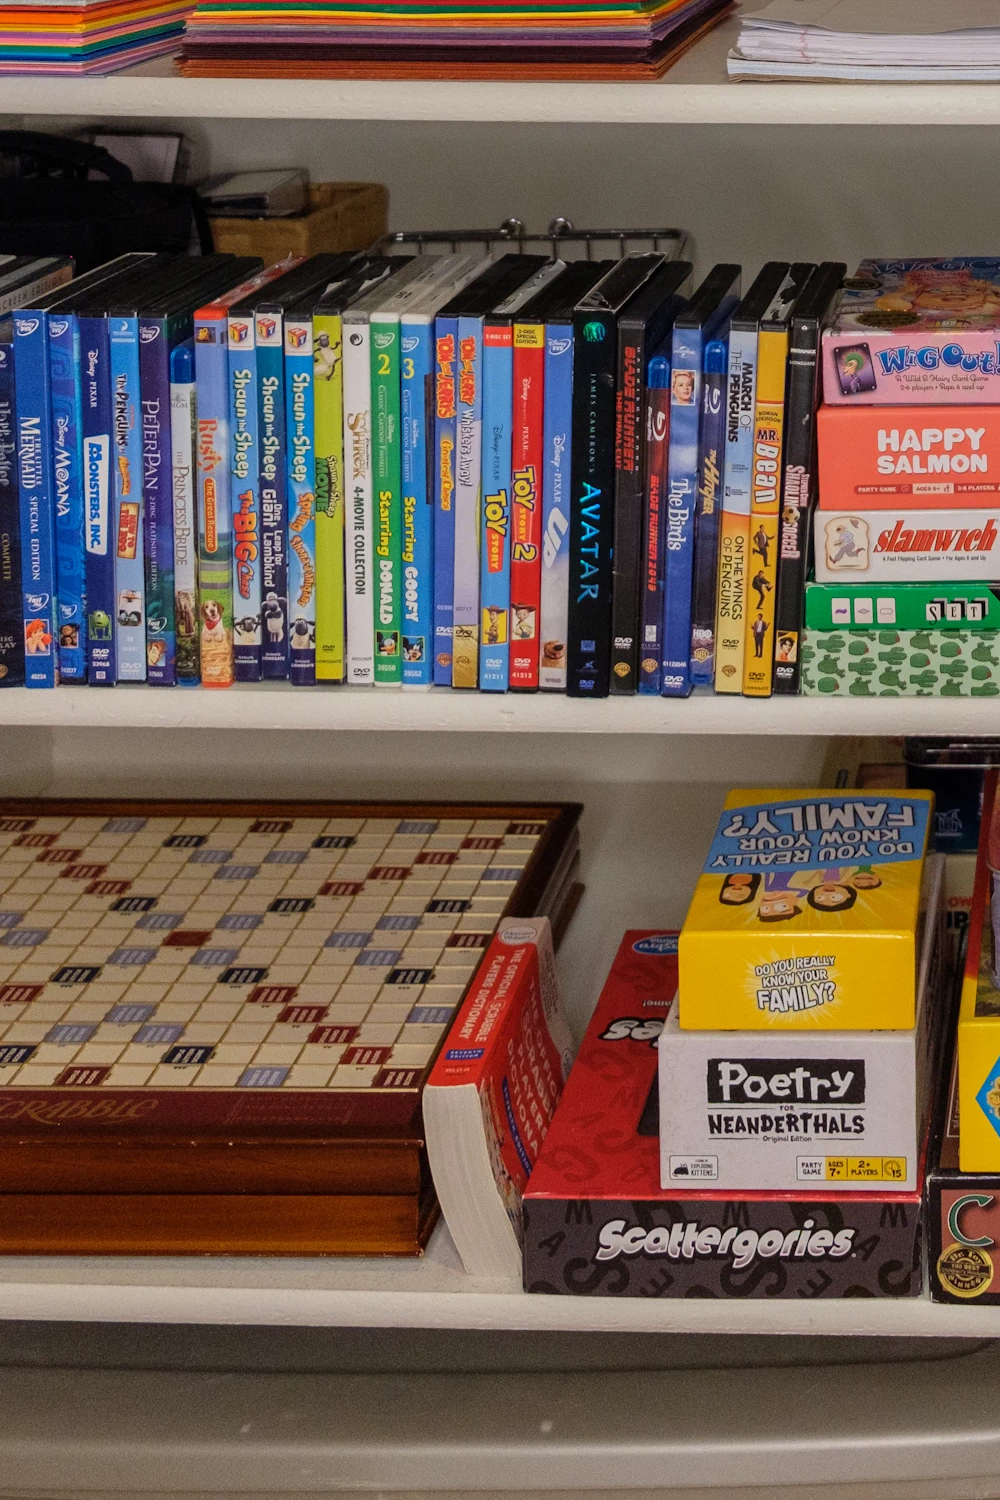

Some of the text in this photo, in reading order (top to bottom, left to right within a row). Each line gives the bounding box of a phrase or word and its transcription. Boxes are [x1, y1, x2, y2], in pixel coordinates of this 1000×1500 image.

[378, 354, 391, 375] 2
[403, 358, 415, 379] 3
[460, 336, 476, 361] TOM
[623, 346, 636, 471] BLADE RUNNER
[728, 374, 740, 443] PENGUINS
[740, 362, 753, 412] MARCH
[233, 369, 253, 479] Shaun Sheep
[260, 376, 280, 481] Shaun Sheep
[291, 373, 311, 482] Shaun Sheep
[347, 412, 366, 479] SHREK
[589, 411, 597, 473] CAMERON'S
[877, 427, 986, 452] HAPPY
[19, 416, 40, 489] MERMAID
[877, 454, 988, 475] SALMON
[55, 447, 71, 517] MOANA
[512, 465, 535, 512] TOY
[649, 475, 660, 513] BLADE
[784, 464, 805, 508] SHAOLIN
[173, 466, 191, 566] PRINCESS BRIDE
[207, 497, 215, 549] Great Rescue
[289, 492, 315, 532] Spring
[377, 491, 392, 556] Starring
[402, 496, 417, 563] Starring
[485, 489, 508, 537] TOY
[519, 508, 527, 542] STORY
[667, 509, 689, 551] Birds
[29, 496, 40, 580] SPECIAL EDITION
[263, 532, 275, 587] Lambkind
[353, 486, 366, 595] 4-MOVIE COLLECTION
[489, 533, 499, 570] STORY
[543, 507, 569, 568] UP
[577, 481, 602, 603] AVATAR
[647, 515, 658, 592] RUNNER 2049
[781, 522, 800, 560] SOCCER
[873, 519, 998, 553] slamwich
[379, 560, 393, 625] DONALD
[405, 566, 419, 623] GOOFY
[720, 554, 733, 618] PENGUINS
[732, 576, 744, 620] WINGS
[722, 802, 915, 837] FAMILY?
[739, 828, 899, 850] KNOW YOUR
[711, 842, 913, 868] DO YOU REALLY
[482, 955, 505, 988] PLAYERS
[494, 965, 518, 1000] OFFICIAL
[755, 956, 836, 976] DO YOU REALLY
[762, 970, 827, 988] KNOW YOUR
[459, 989, 490, 1039] DICTIONARY
[757, 982, 836, 1013] FAMILY?
[475, 1002, 501, 1043] SCRABBLE
[718, 1061, 855, 1101] Poetry
[707, 1112, 865, 1135] NEANDERTHALS
[762, 1135, 789, 1143] Original
[595, 1219, 855, 1269] Scattergories
